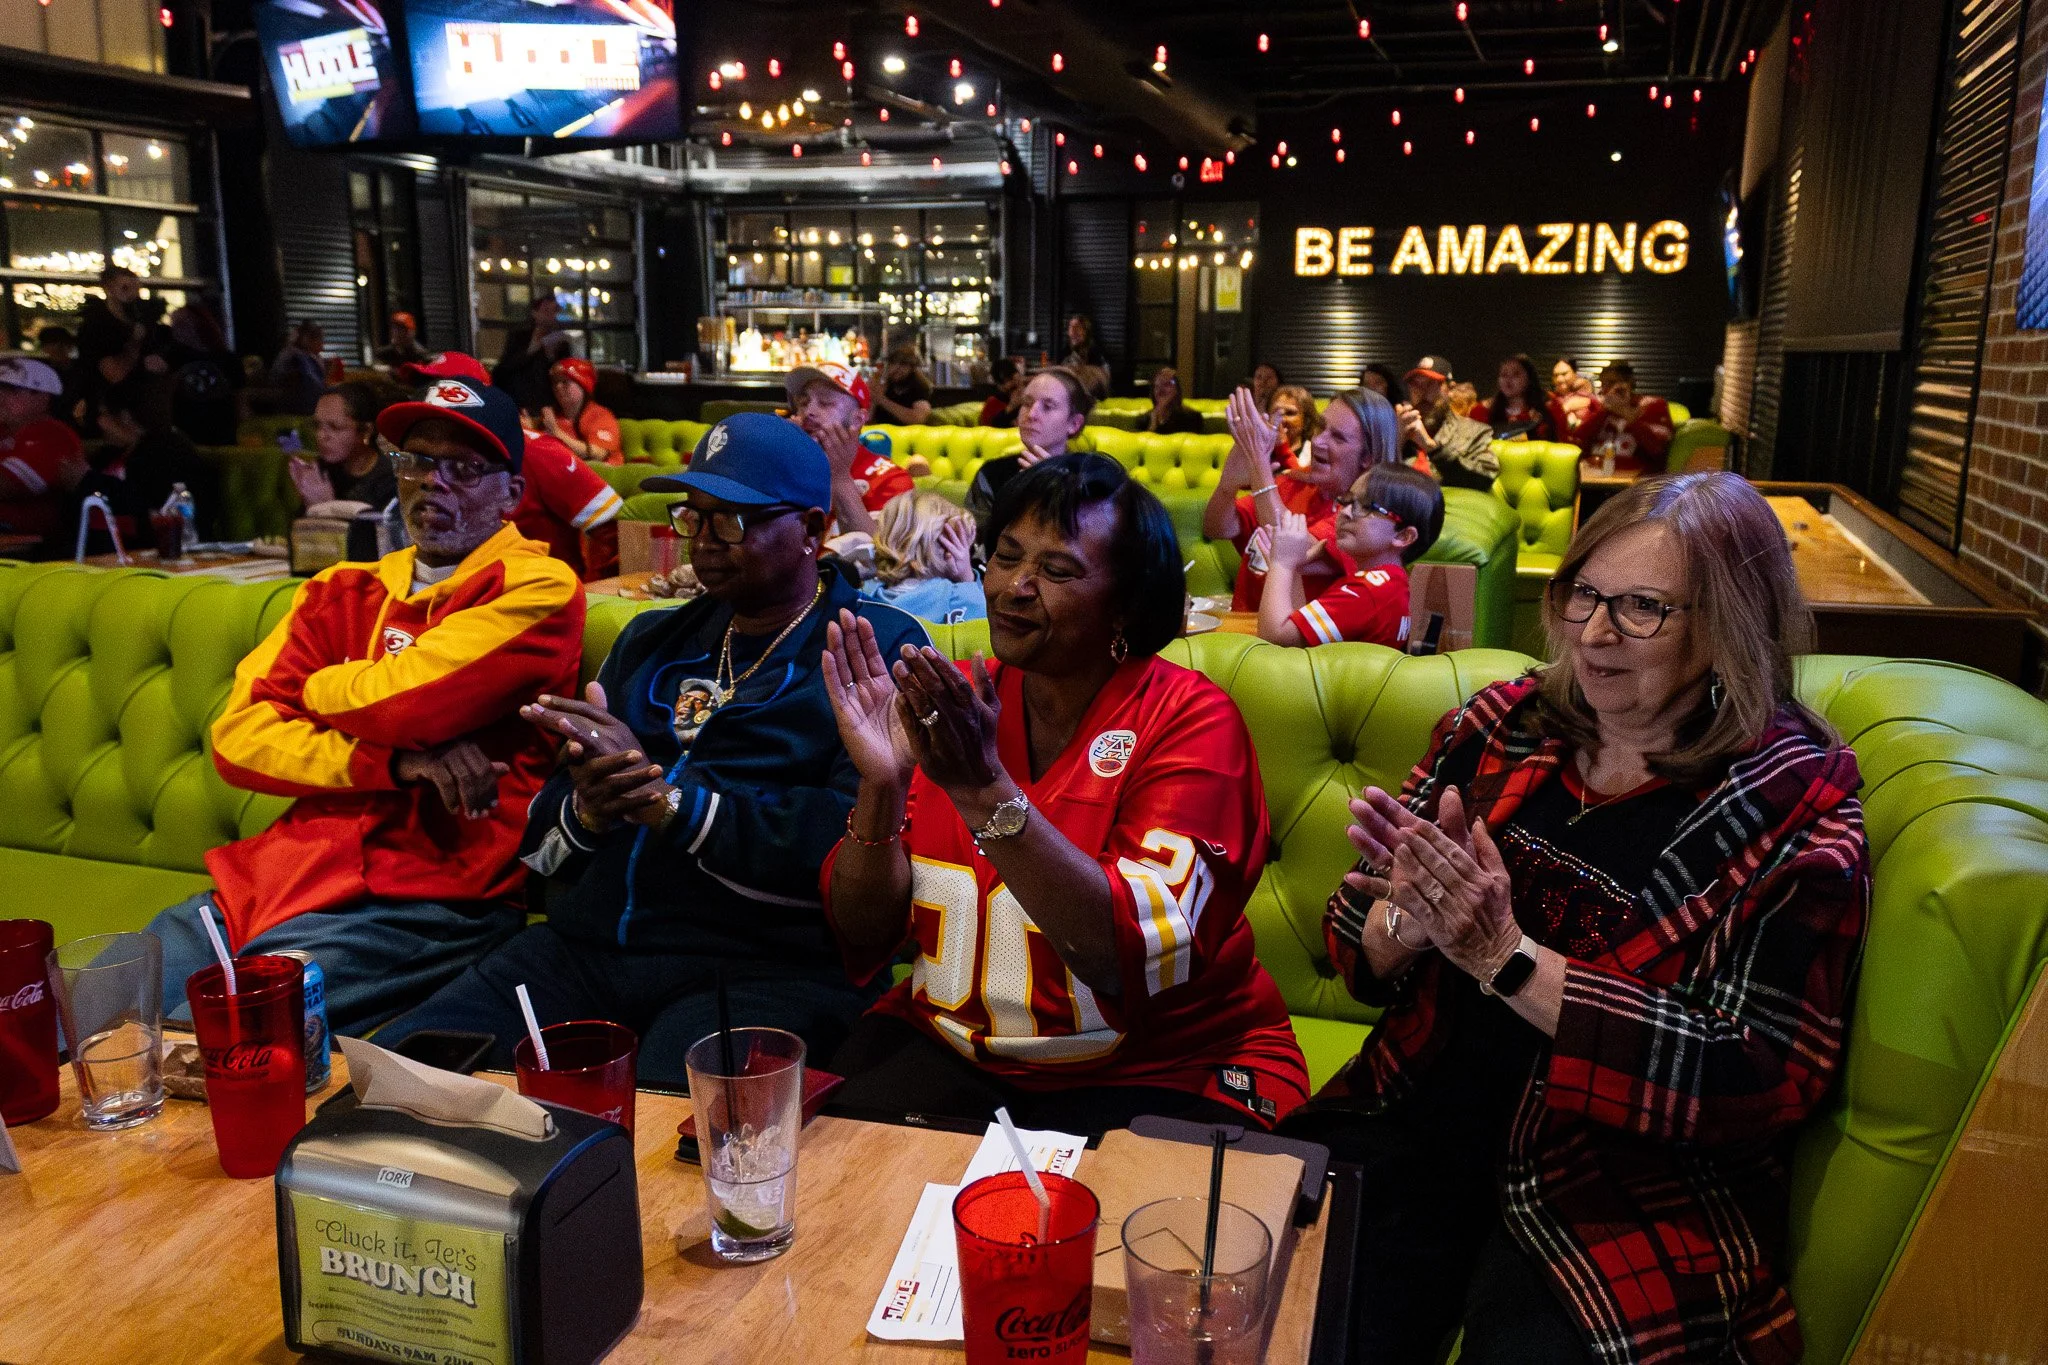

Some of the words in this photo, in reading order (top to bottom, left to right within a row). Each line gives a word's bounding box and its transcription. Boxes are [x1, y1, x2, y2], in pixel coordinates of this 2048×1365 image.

[1295, 227, 1375, 276] BE
[1390, 219, 1690, 275] AMAZING
[1226, 1071, 1248, 1087] NFL
[379, 1170, 411, 1183] TORK
[315, 1219, 385, 1256] Cluck
[425, 1239, 477, 1272] Let's
[319, 1246, 477, 1307] BRUNCH
[336, 1326, 402, 1356] SUNDAYS
[1007, 1346, 1050, 1360] zero
